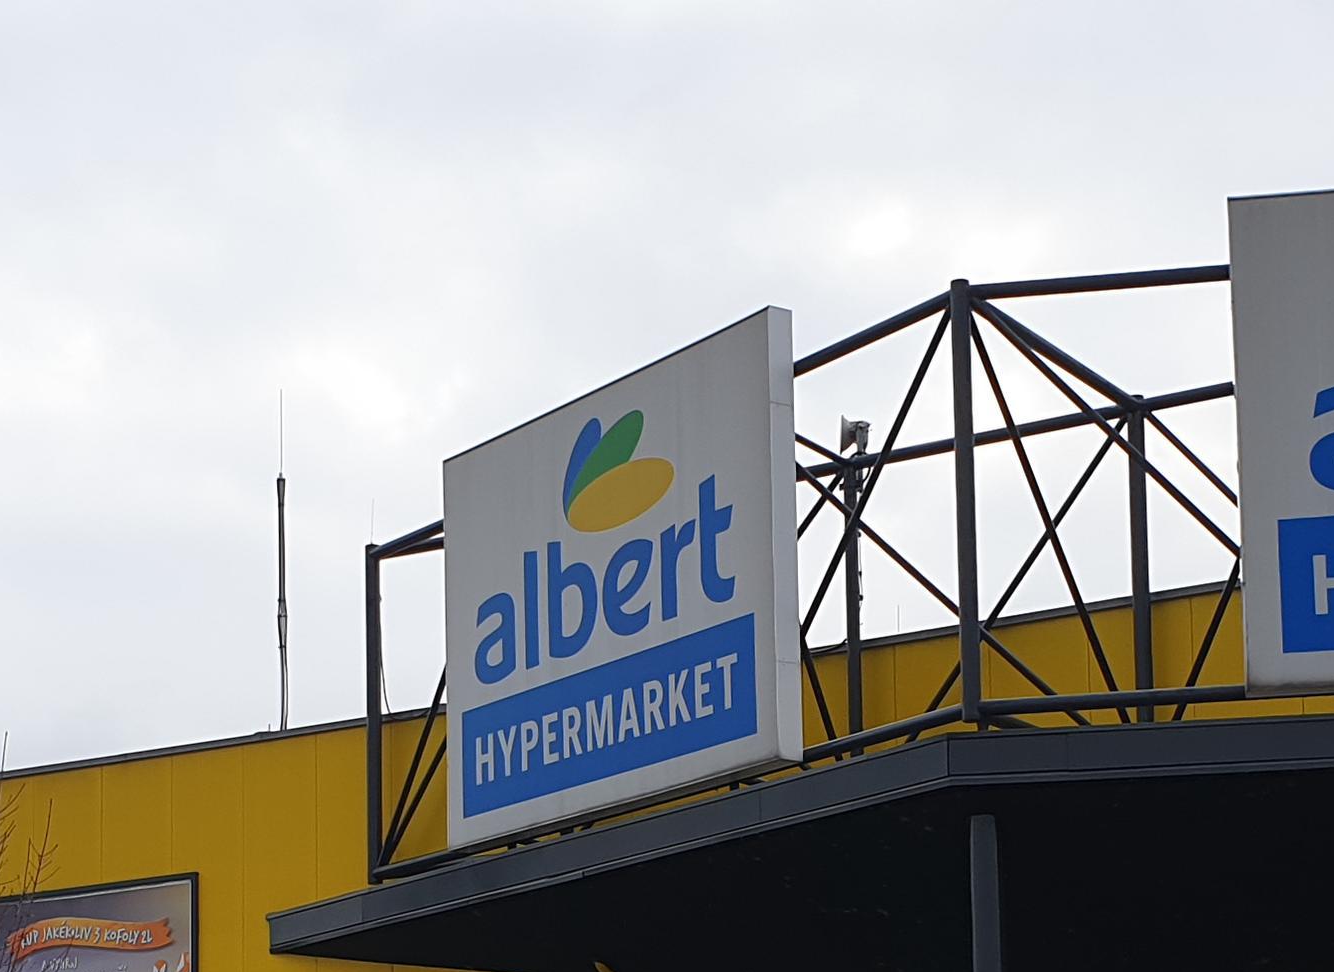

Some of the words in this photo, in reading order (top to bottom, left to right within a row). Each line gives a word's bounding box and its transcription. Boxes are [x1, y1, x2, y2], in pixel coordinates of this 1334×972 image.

[475, 473, 737, 685] albert
[474, 653, 740, 787] HYPERMARKET
[94, 926, 102, 944] 3
[104, 928, 139, 945] KOFOLY
